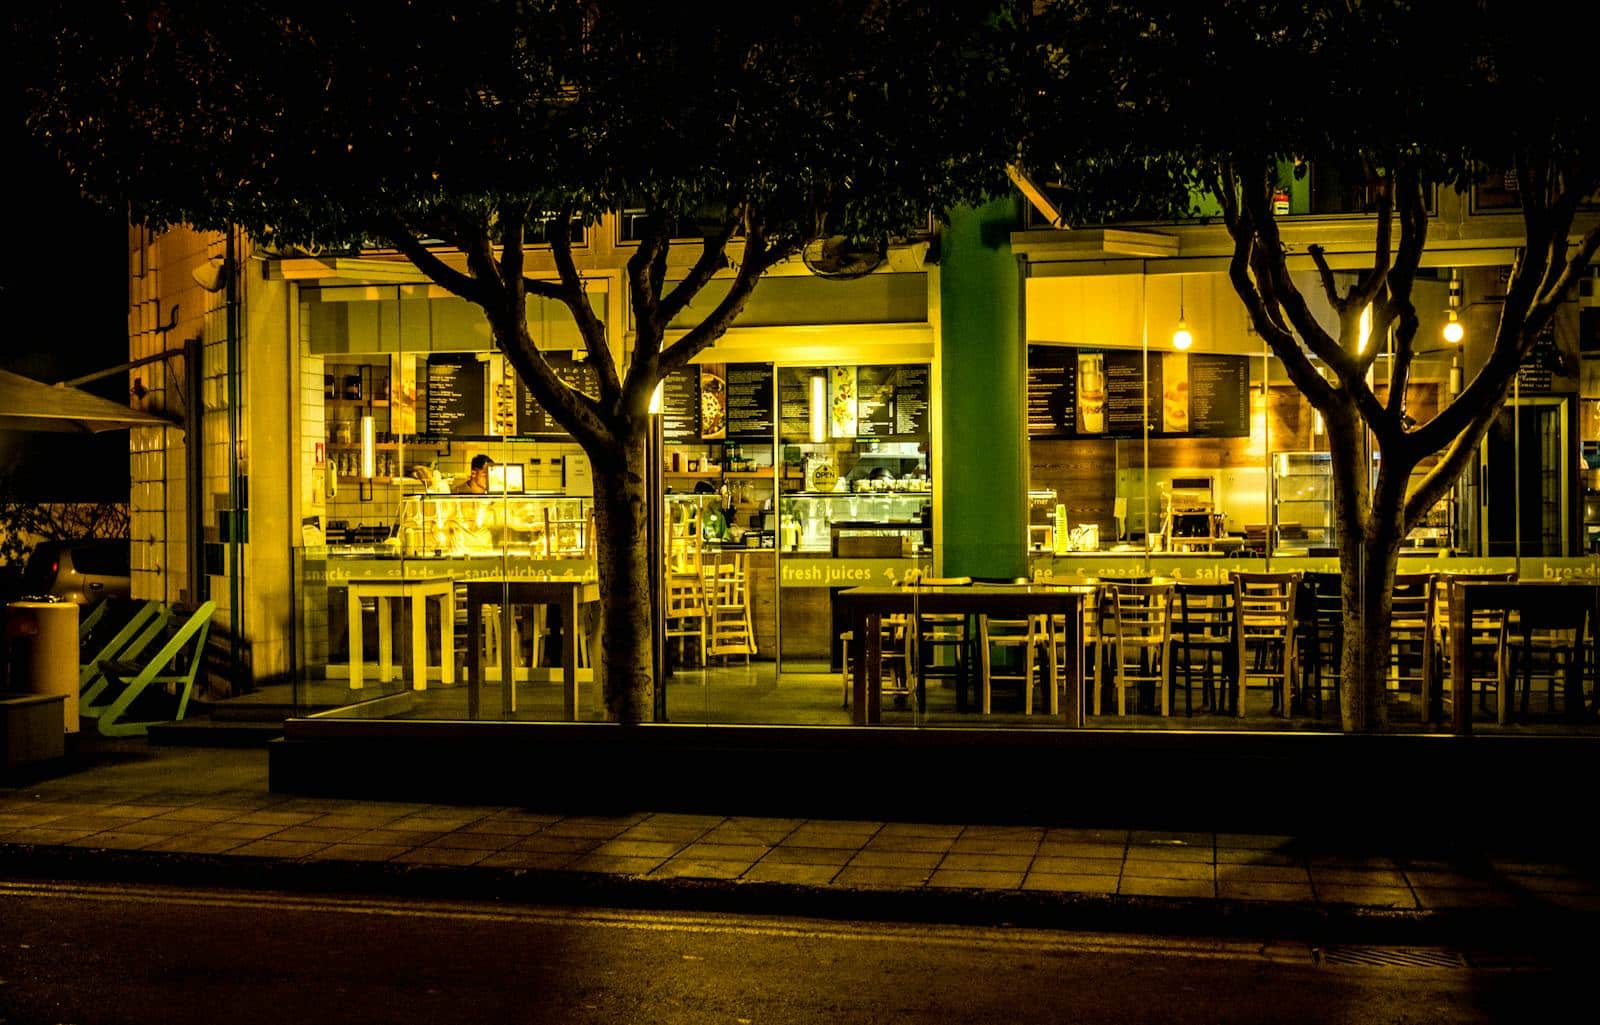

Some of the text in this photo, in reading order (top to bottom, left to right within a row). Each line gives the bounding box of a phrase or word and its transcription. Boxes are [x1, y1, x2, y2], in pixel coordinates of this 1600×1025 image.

[465, 566, 552, 578] sandwiches
[782, 565, 822, 581] fresh
[824, 565, 872, 583] juices
